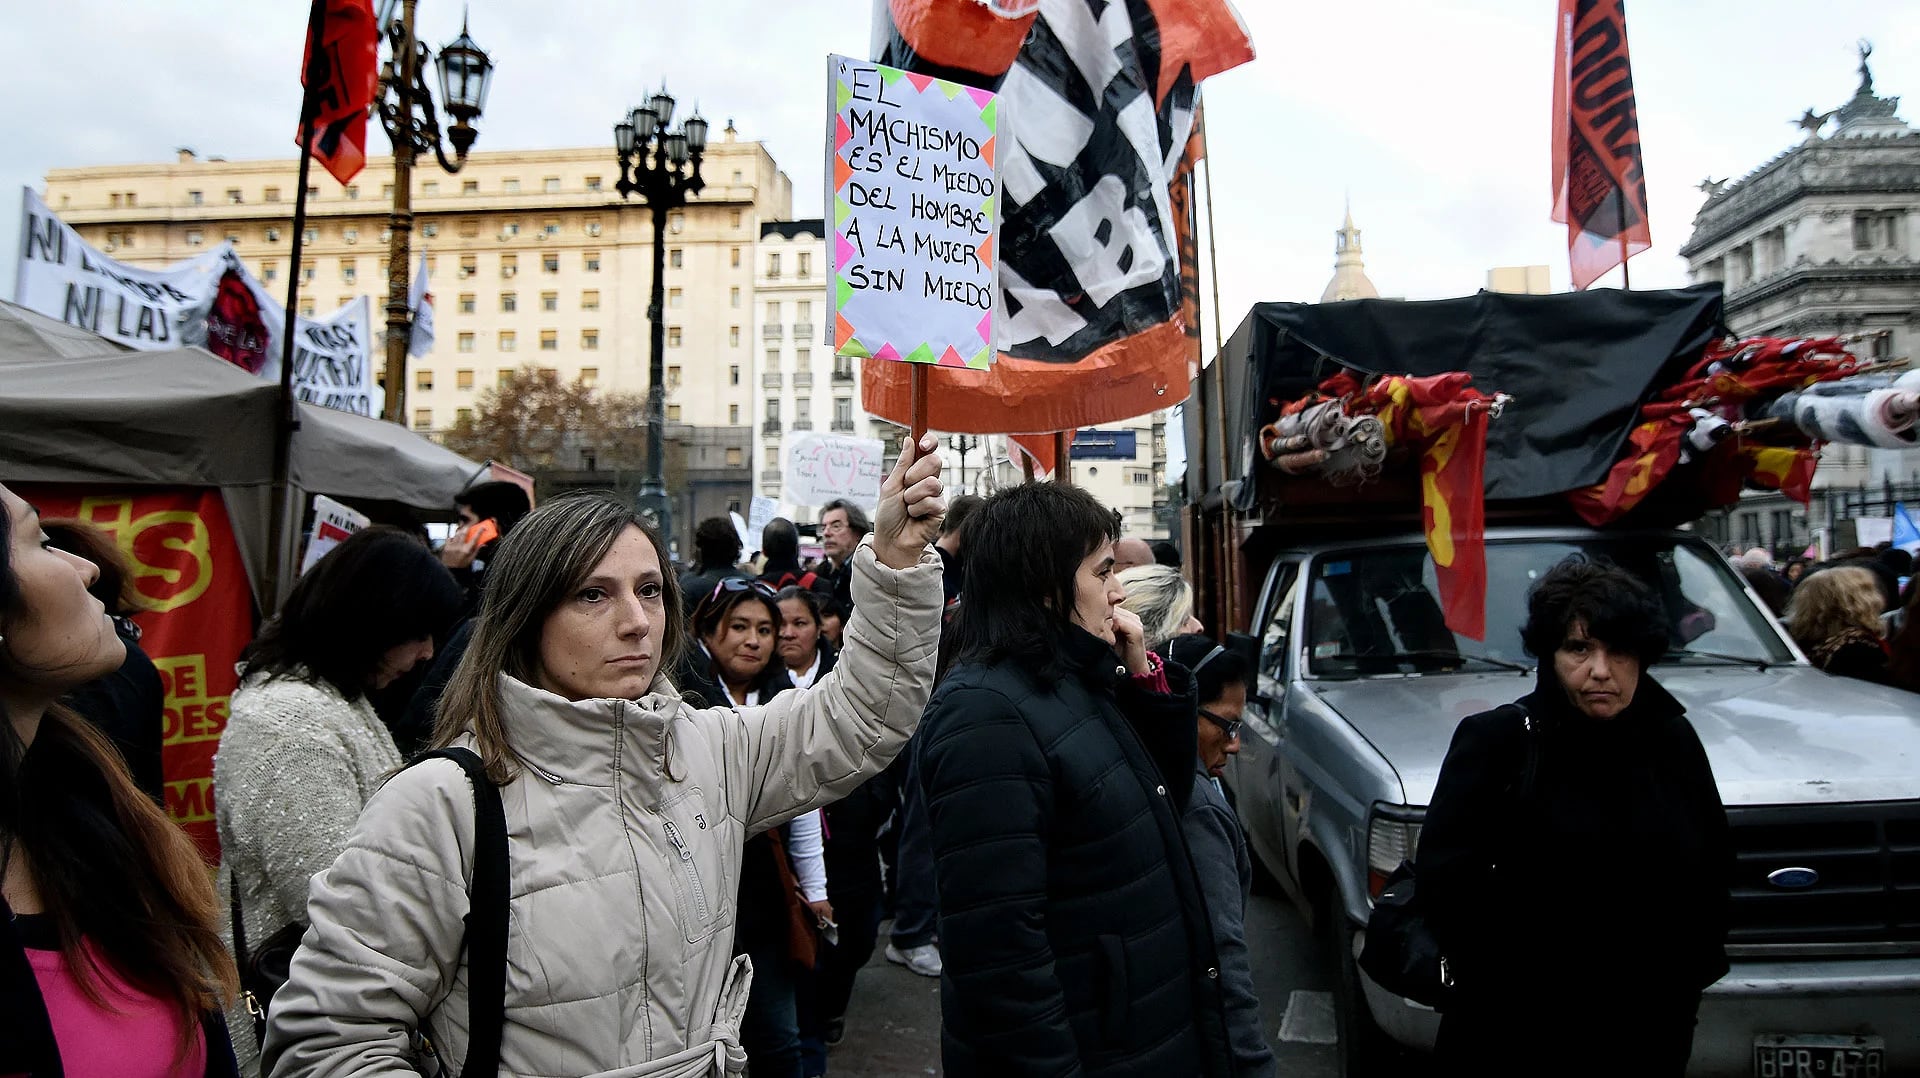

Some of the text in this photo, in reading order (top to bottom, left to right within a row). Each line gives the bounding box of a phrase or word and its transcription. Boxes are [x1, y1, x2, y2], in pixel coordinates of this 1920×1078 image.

[850, 108, 980, 162] MACHISMO
[849, 147, 994, 197] ES EL MIEDO
[849, 182, 989, 236] DEL HOMBRE
[26, 214, 66, 265] NI
[846, 217, 980, 274] A LA MUJER
[848, 265, 905, 292] SIN
